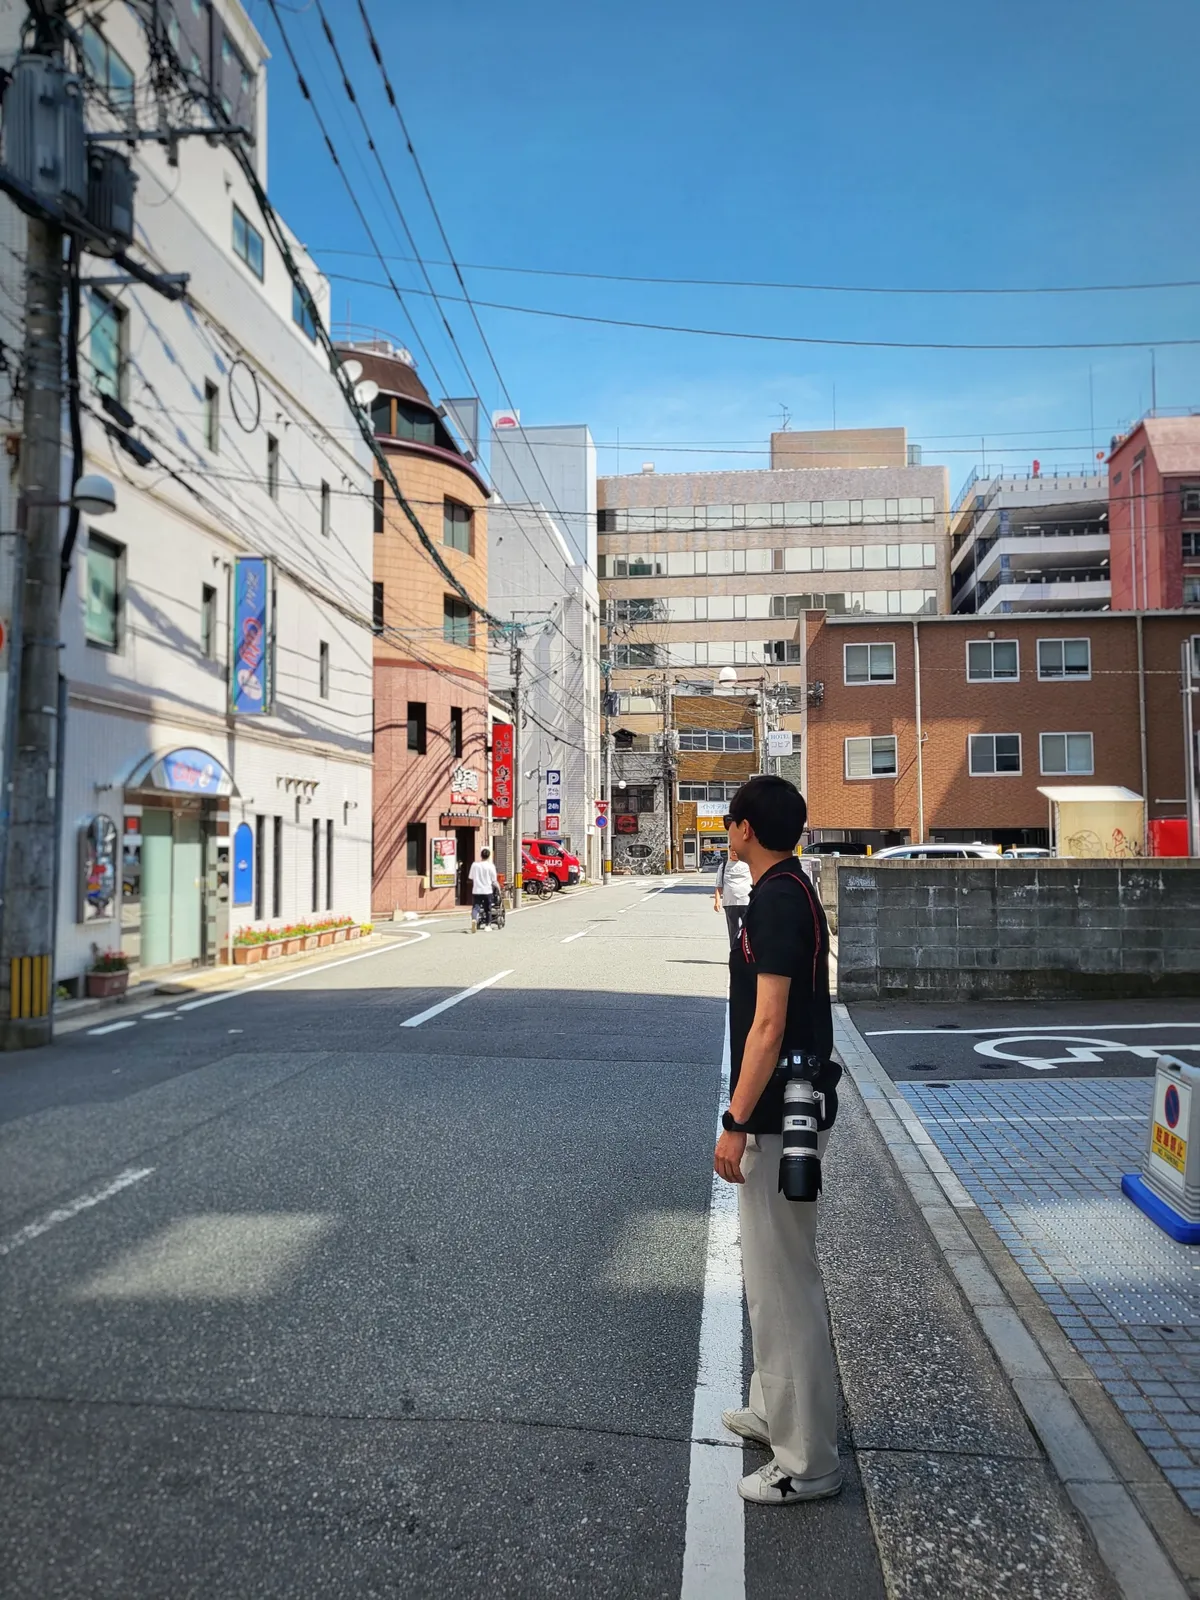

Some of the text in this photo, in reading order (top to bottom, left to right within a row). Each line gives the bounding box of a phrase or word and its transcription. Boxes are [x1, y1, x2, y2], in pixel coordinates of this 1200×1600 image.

[548, 772, 560, 785] P
[547, 802, 560, 810] 24h
[547, 817, 558, 829] 酒
[1156, 1126, 1183, 1158] 駐車禁止
